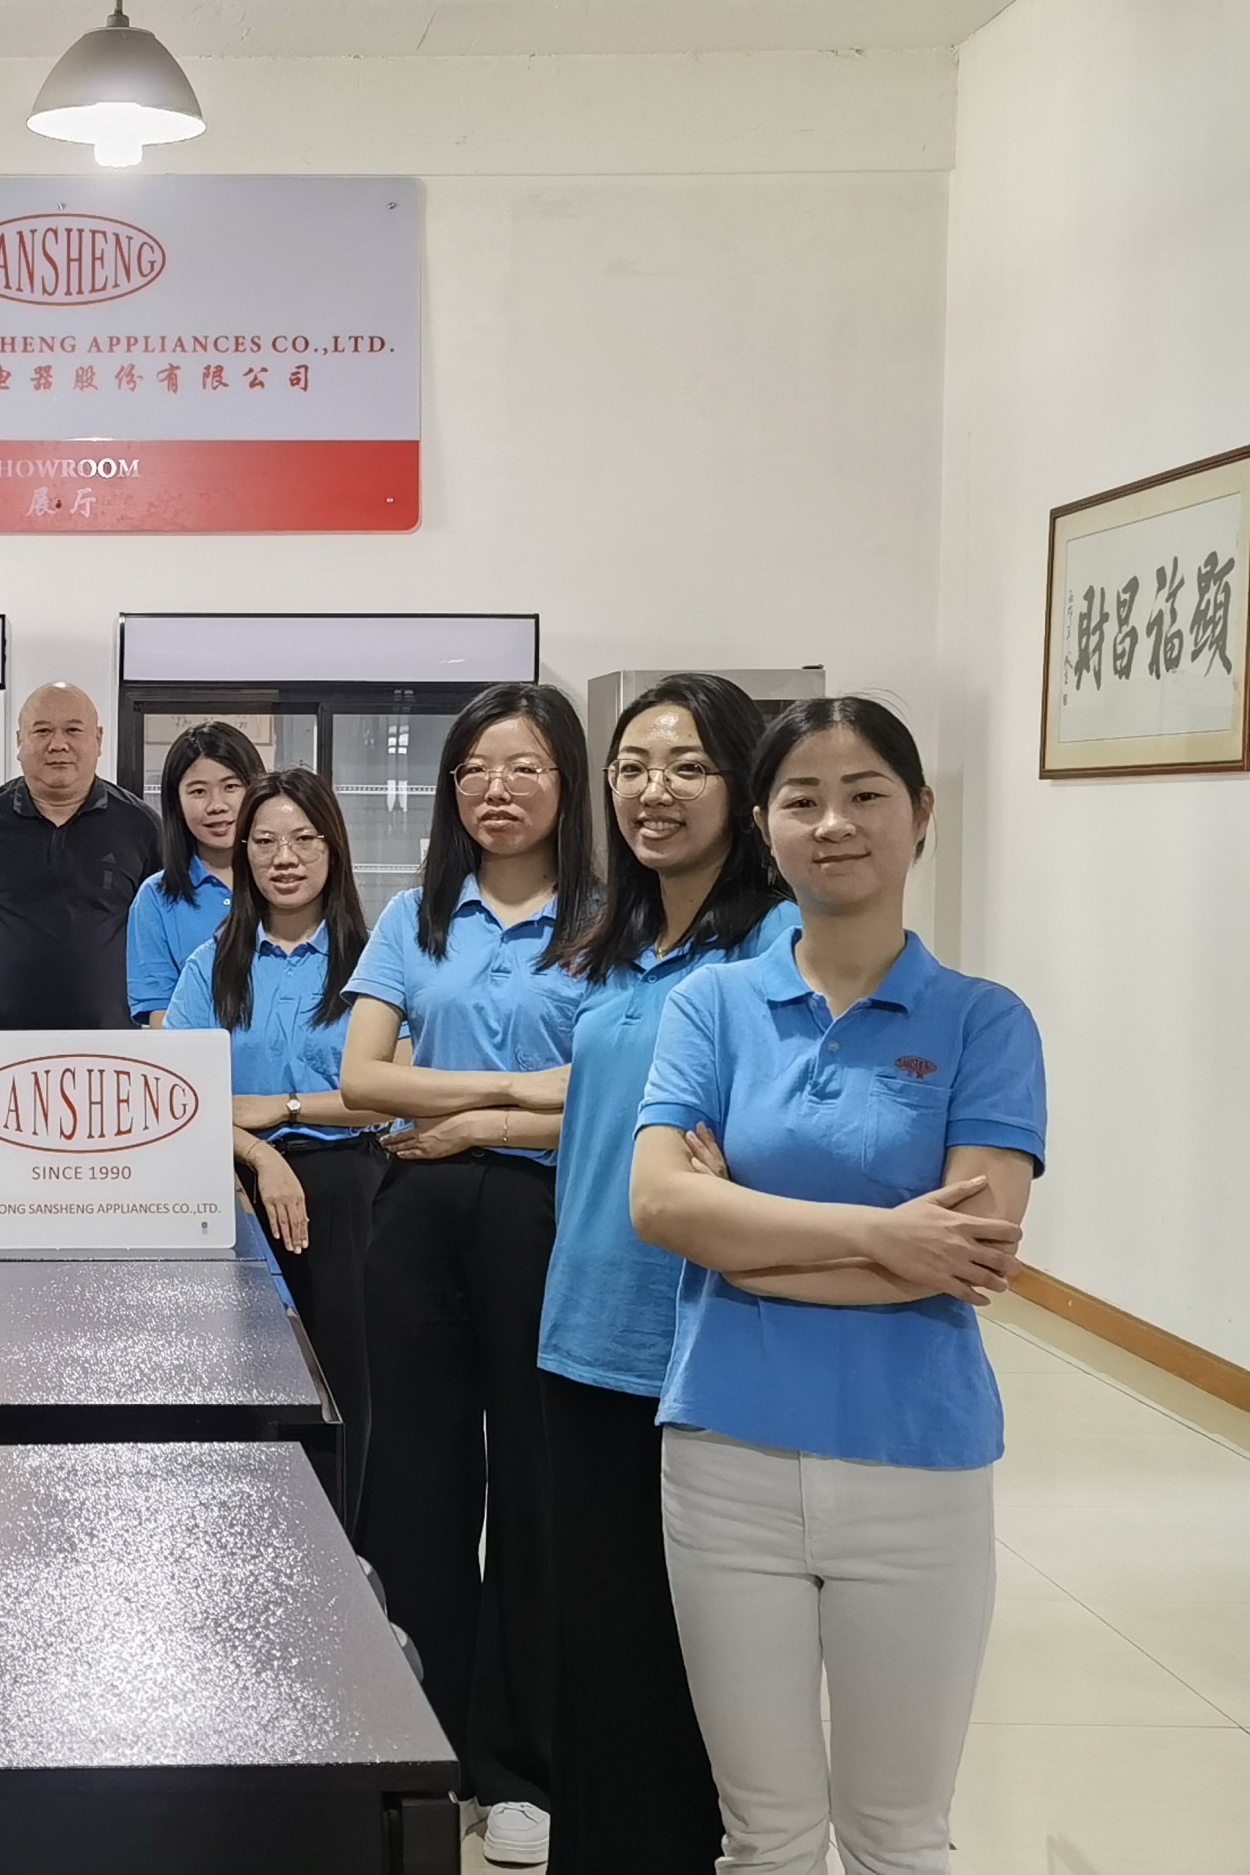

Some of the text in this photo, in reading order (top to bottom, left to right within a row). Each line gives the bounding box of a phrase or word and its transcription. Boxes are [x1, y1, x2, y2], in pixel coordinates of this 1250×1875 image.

[87, 334, 264, 354] APPLIANCES
[271, 334, 396, 357] CO.,LTD.
[25, 486, 97, 519] 展厅
[31, 1165, 132, 1181] SINCE 1990
[28, 1203, 95, 1216] SANSHENG
[96, 1203, 170, 1216] APPLIANCES
[172, 1203, 222, 1217] CO.,LTD.
